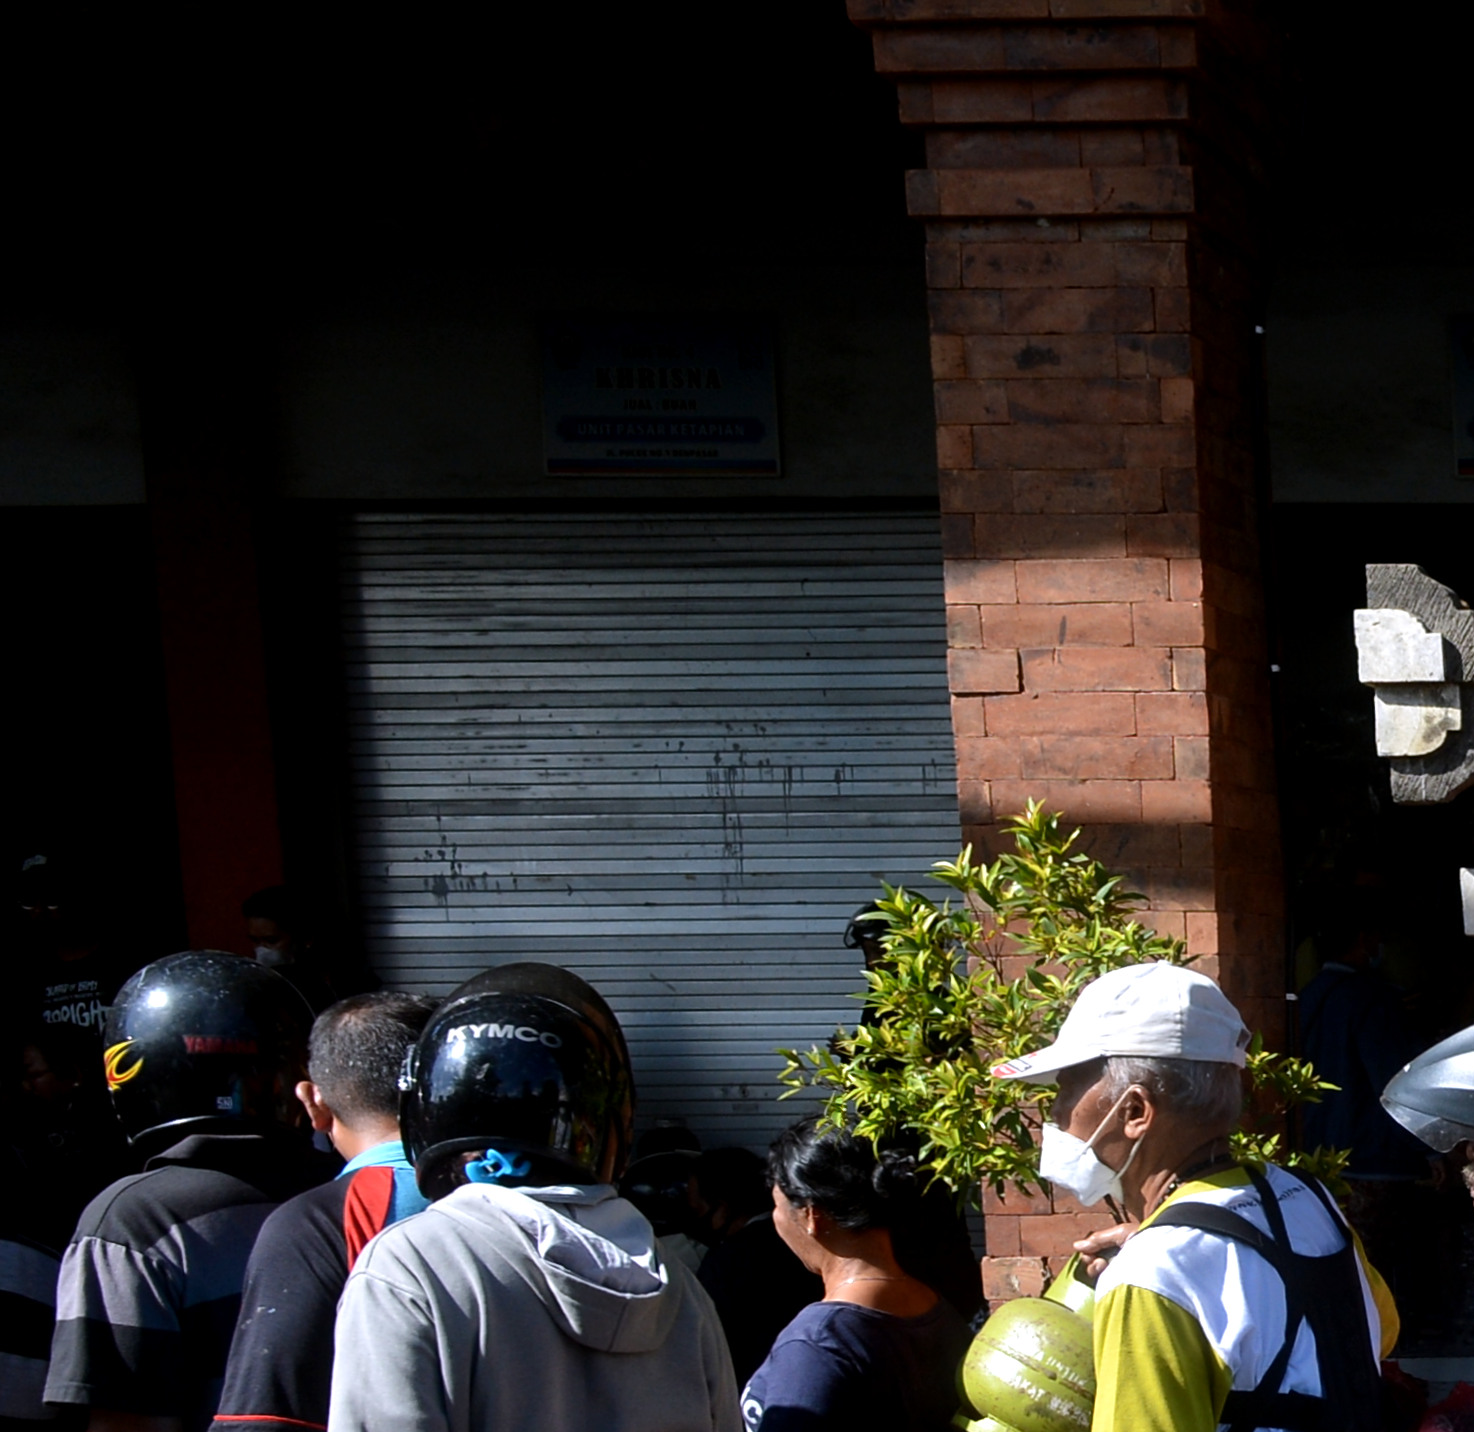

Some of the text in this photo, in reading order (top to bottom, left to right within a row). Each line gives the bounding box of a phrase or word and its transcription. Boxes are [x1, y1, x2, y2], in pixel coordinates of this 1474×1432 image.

[595, 367, 722, 389] KHRISNA
[577, 423, 745, 436] UNIT PASAR KETAPIAN
[446, 1023, 563, 1048] KYMCO
